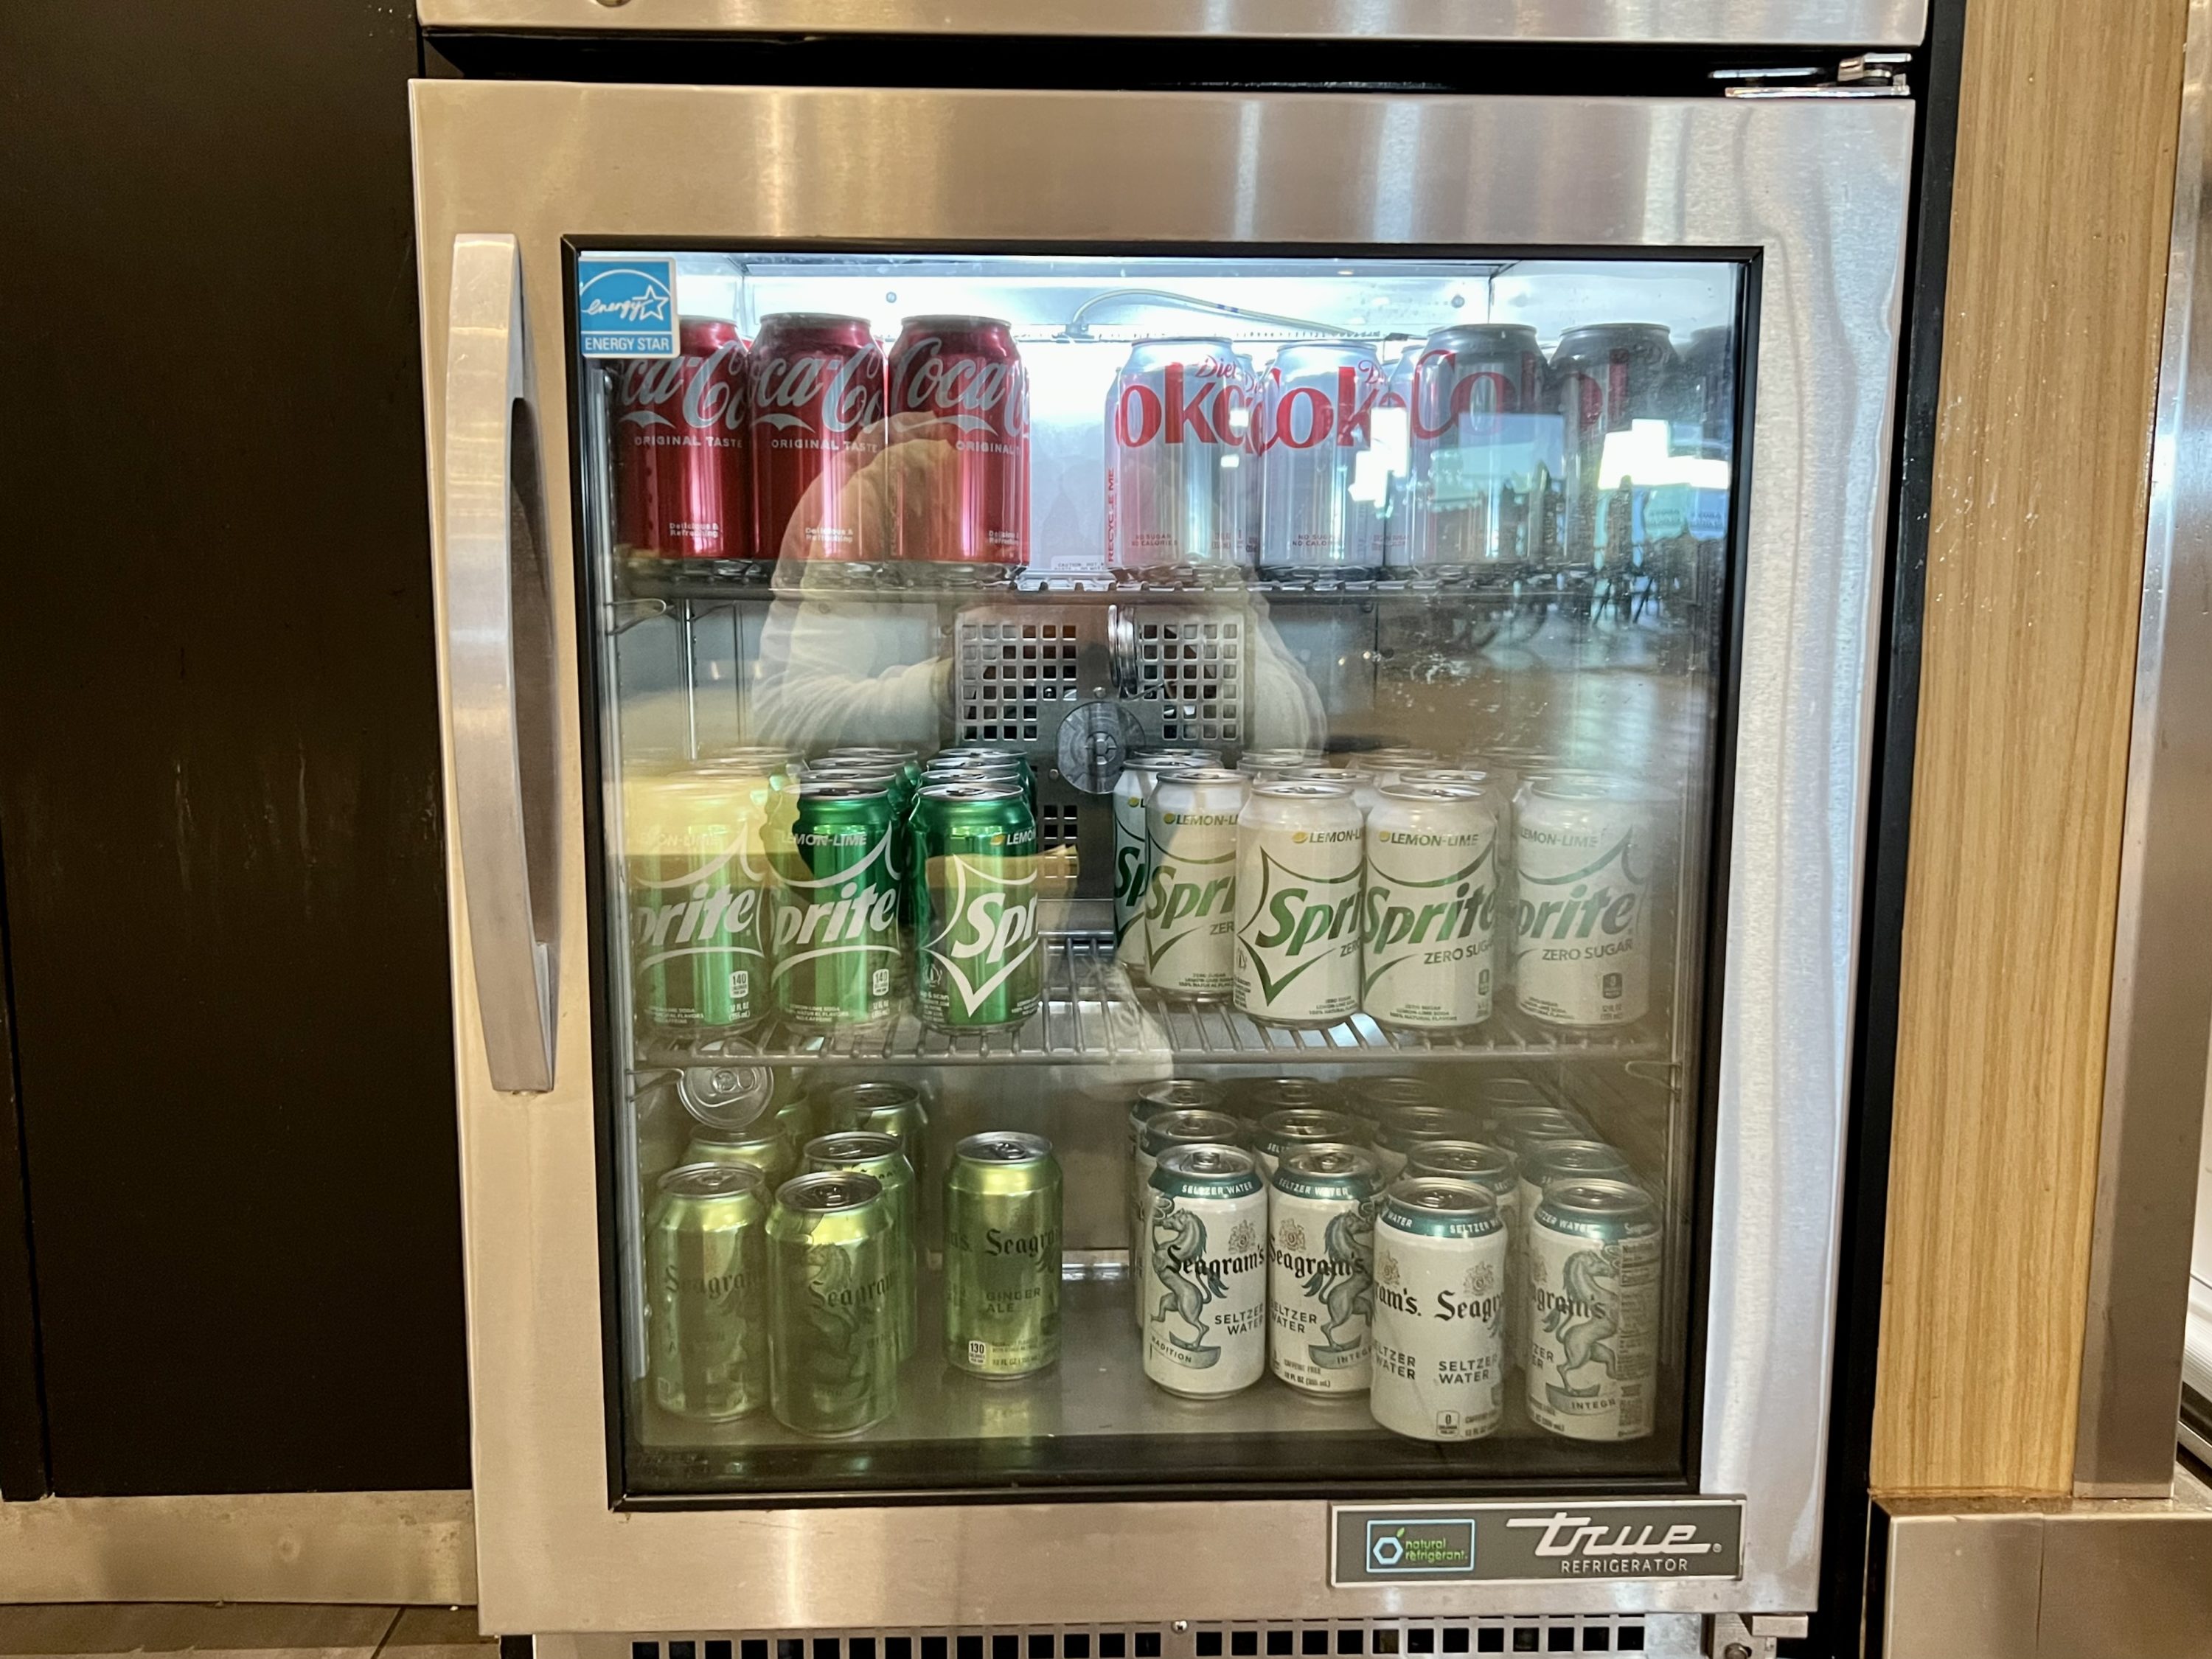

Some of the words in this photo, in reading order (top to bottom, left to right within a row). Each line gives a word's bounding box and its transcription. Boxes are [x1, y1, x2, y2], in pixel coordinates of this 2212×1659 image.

[585, 337, 634, 351] ENERGY
[637, 337, 669, 351] STAR
[633, 435, 702, 447] ORIGINAL
[705, 436, 742, 448] TASTE
[771, 439, 839, 451] ORIGINAL
[844, 440, 878, 453] TASTE
[956, 439, 1015, 454] ORIGINAL
[782, 832, 867, 846] LEMON-LIME
[1391, 832, 1479, 847] LEMON-LIME
[1363, 881, 1498, 955] Sprite
[1424, 947, 1464, 964] ZERO
[1542, 947, 1582, 961] ZERO
[1584, 938, 1633, 959] SUGAR
[732, 973, 747, 985] 140
[875, 971, 888, 984] 140
[1225, 1180, 1253, 1195] WATER
[1449, 1220, 1489, 1235] SELTZER
[1164, 1243, 1265, 1281] Seagram's
[986, 1287, 1042, 1302] GINGER
[986, 1303, 1015, 1313] ALE
[1214, 1302, 1264, 1325] SELTZER
[970, 1342, 985, 1354] 130
[1438, 1353, 1498, 1372] SELTZER
[1438, 1368, 1489, 1385] WATER
[1405, 1537, 1447, 1550] natural
[1560, 1558, 1688, 1573] REFRIGERATOR
